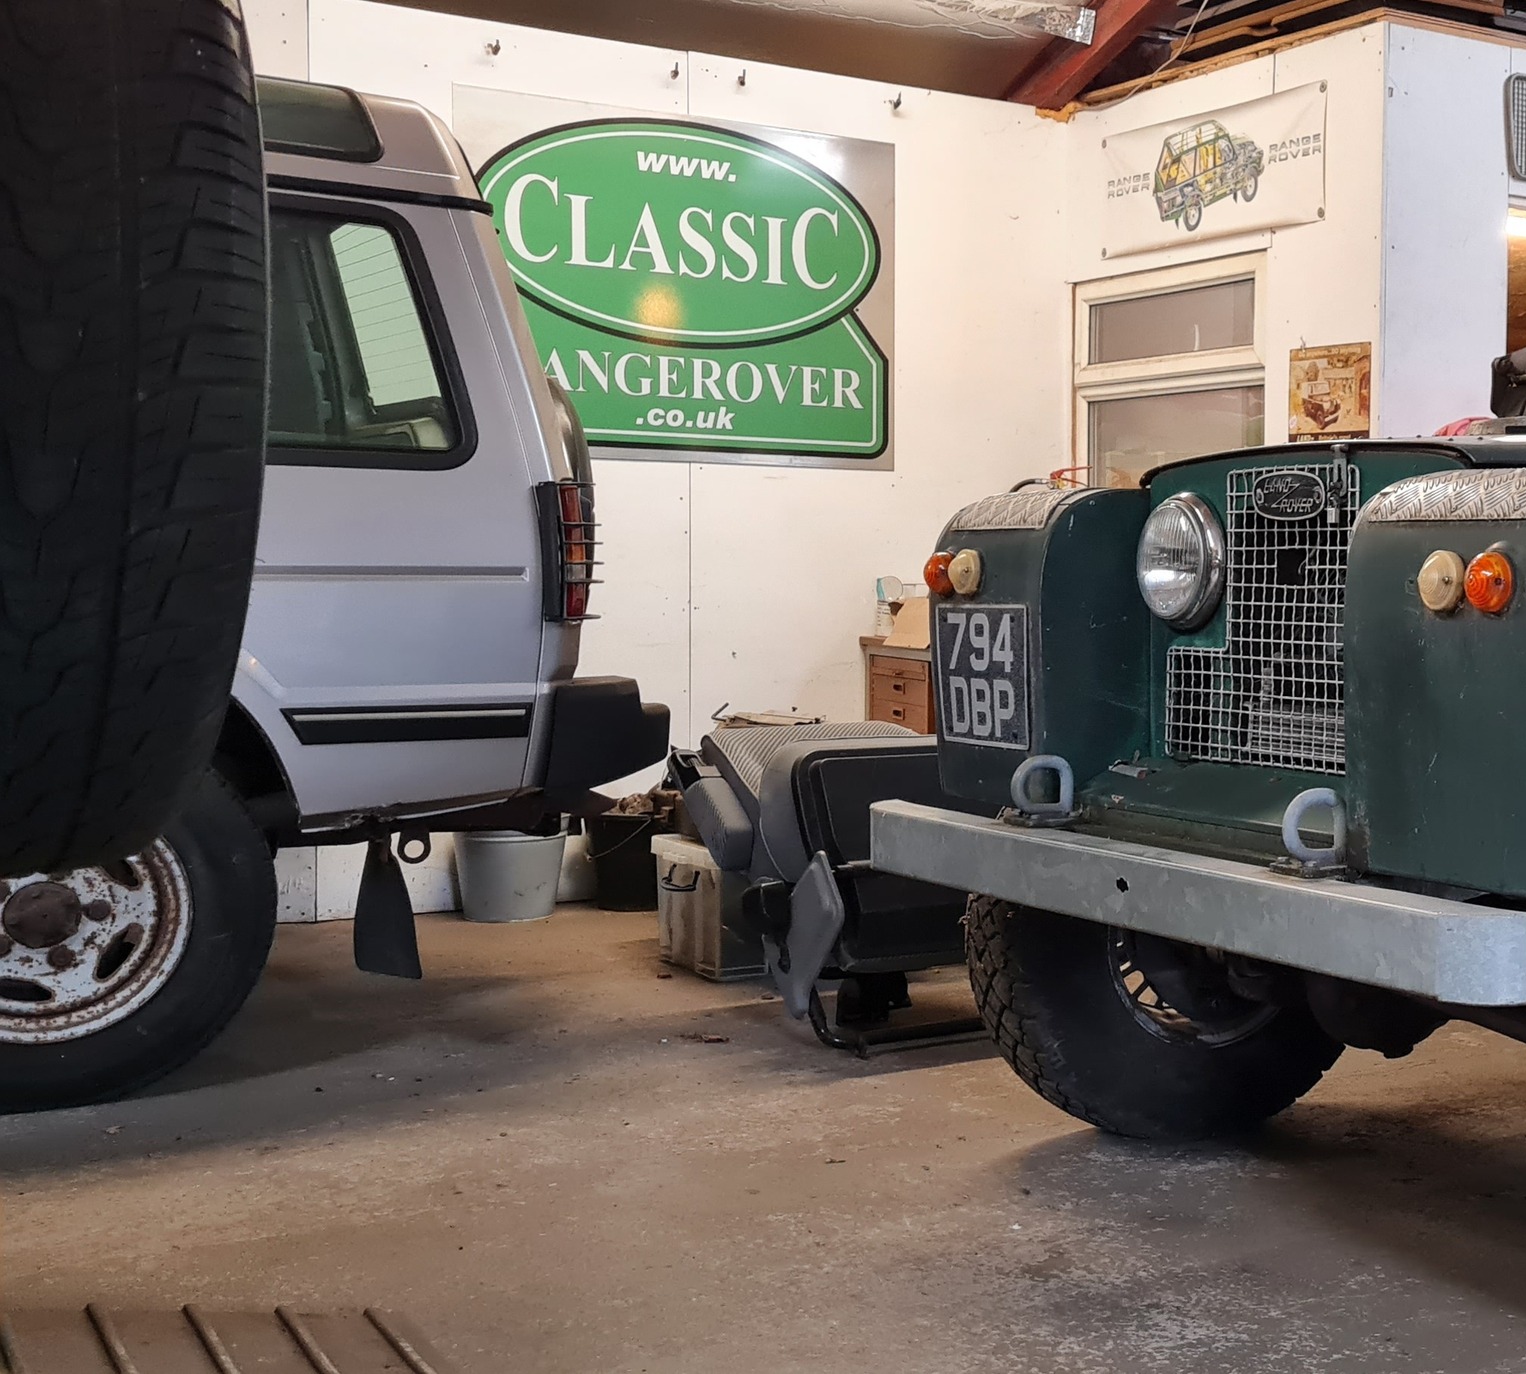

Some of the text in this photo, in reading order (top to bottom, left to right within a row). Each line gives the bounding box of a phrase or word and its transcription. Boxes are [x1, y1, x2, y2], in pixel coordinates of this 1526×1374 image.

[1267, 144, 1322, 164] ROVER
[1268, 132, 1322, 154] RANGE
[636, 150, 737, 182] www.
[1107, 172, 1151, 189] RANGE
[1107, 182, 1151, 199] ROVER
[503, 172, 840, 290] CLASSIC
[543, 347, 865, 410] ANGEROVER
[635, 406, 735, 430] .co.uk
[1280, 498, 1314, 513] ROVER
[947, 612, 1014, 673] 794
[949, 676, 1015, 738] DBP
